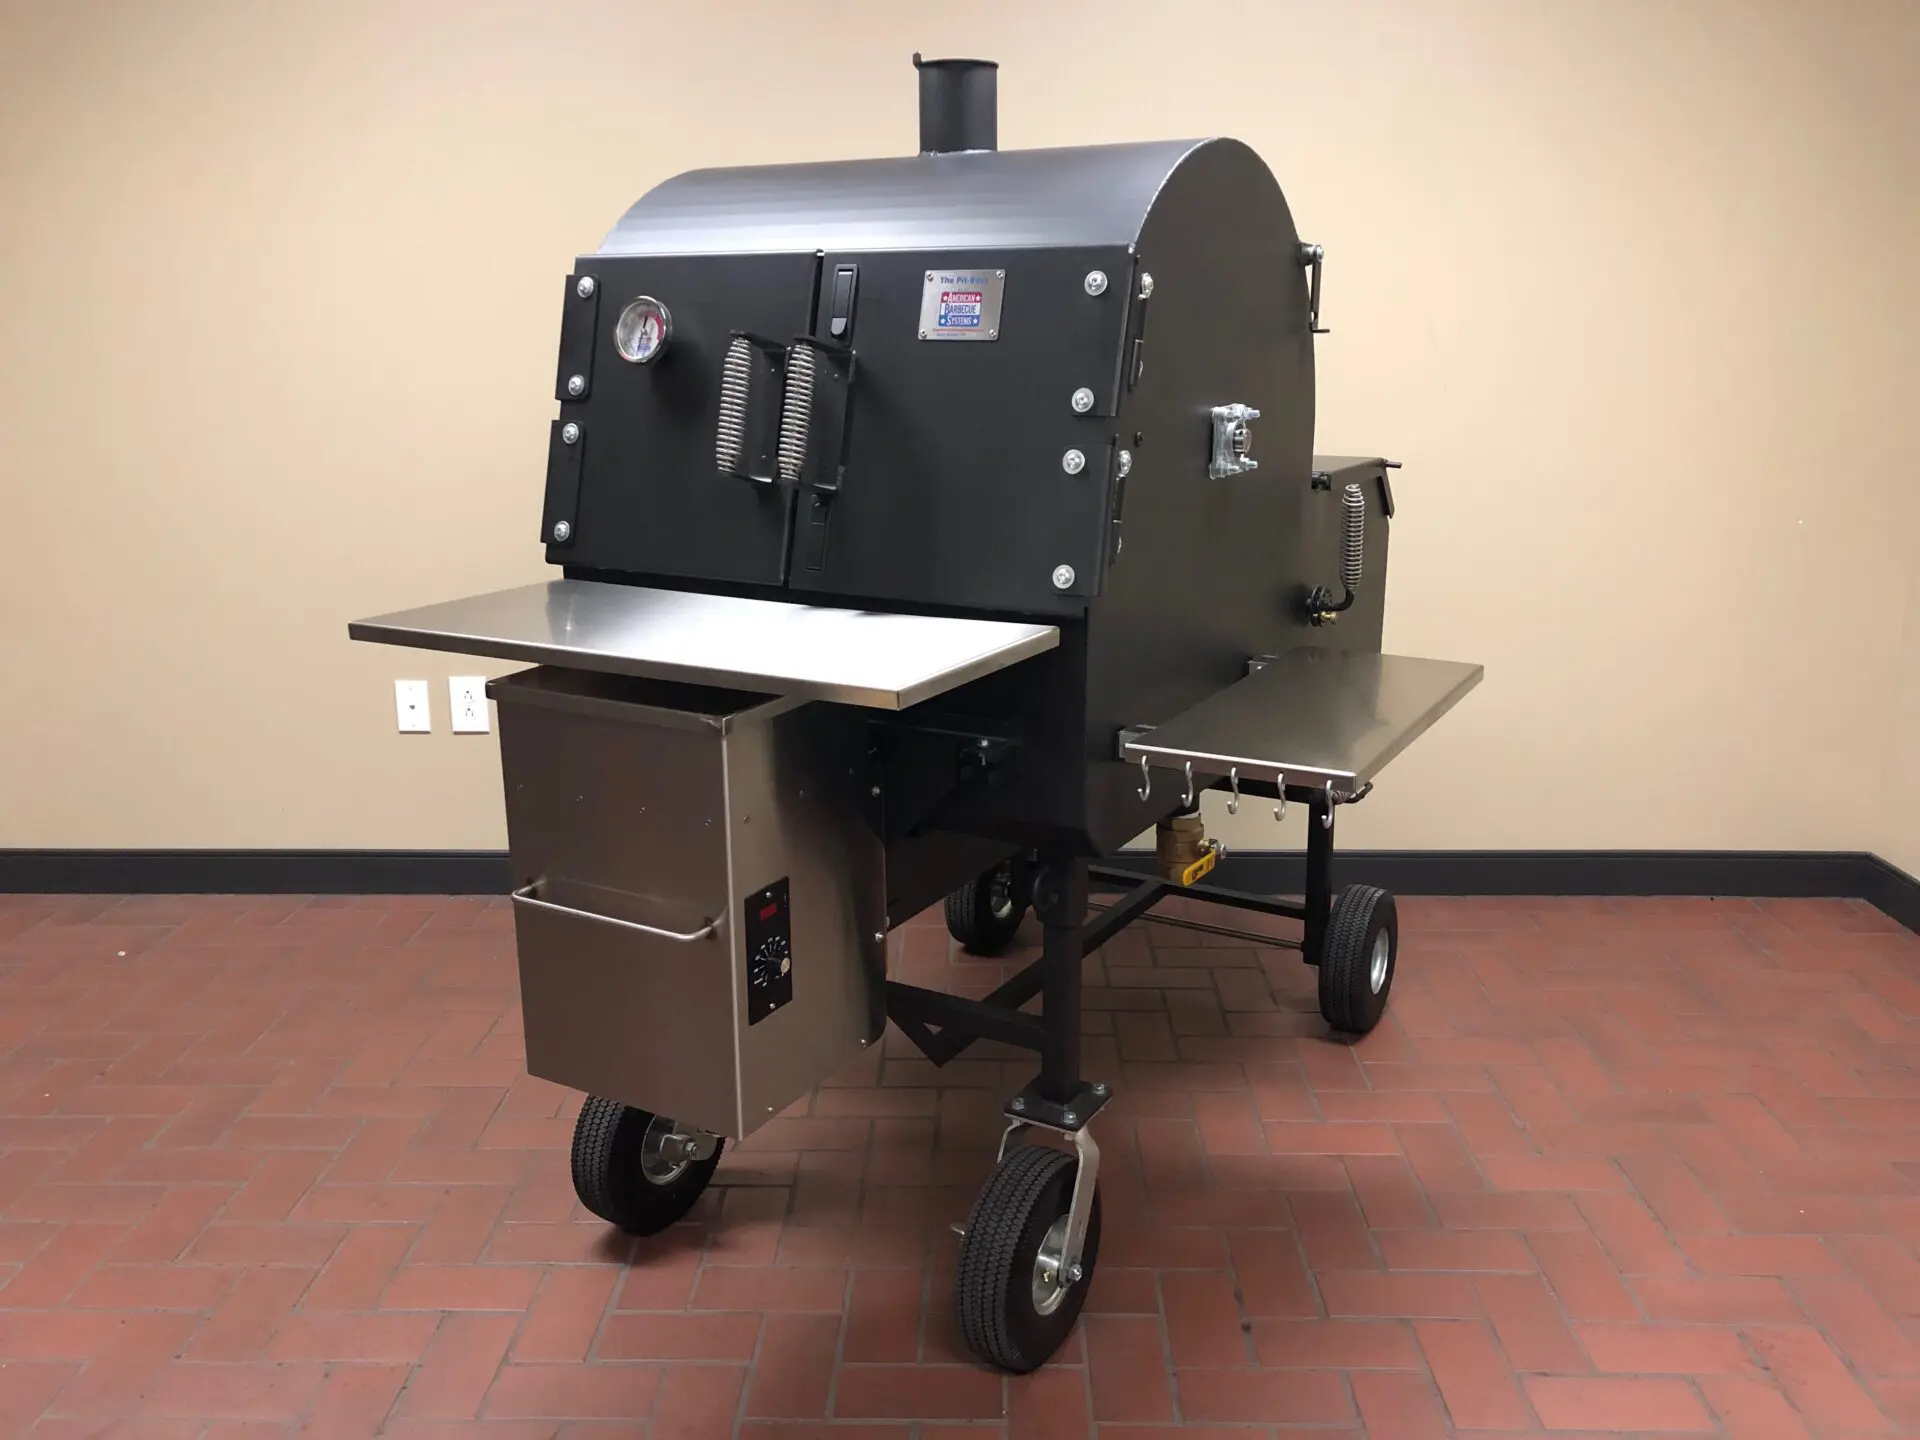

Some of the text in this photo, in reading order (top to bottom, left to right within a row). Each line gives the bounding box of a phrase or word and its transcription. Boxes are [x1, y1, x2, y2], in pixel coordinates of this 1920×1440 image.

[940, 276, 954, 284] The
[947, 292, 976, 303] AMERICAN
[944, 303, 977, 315] BARBECUE
[946, 316, 972, 325] SYSTEMS
